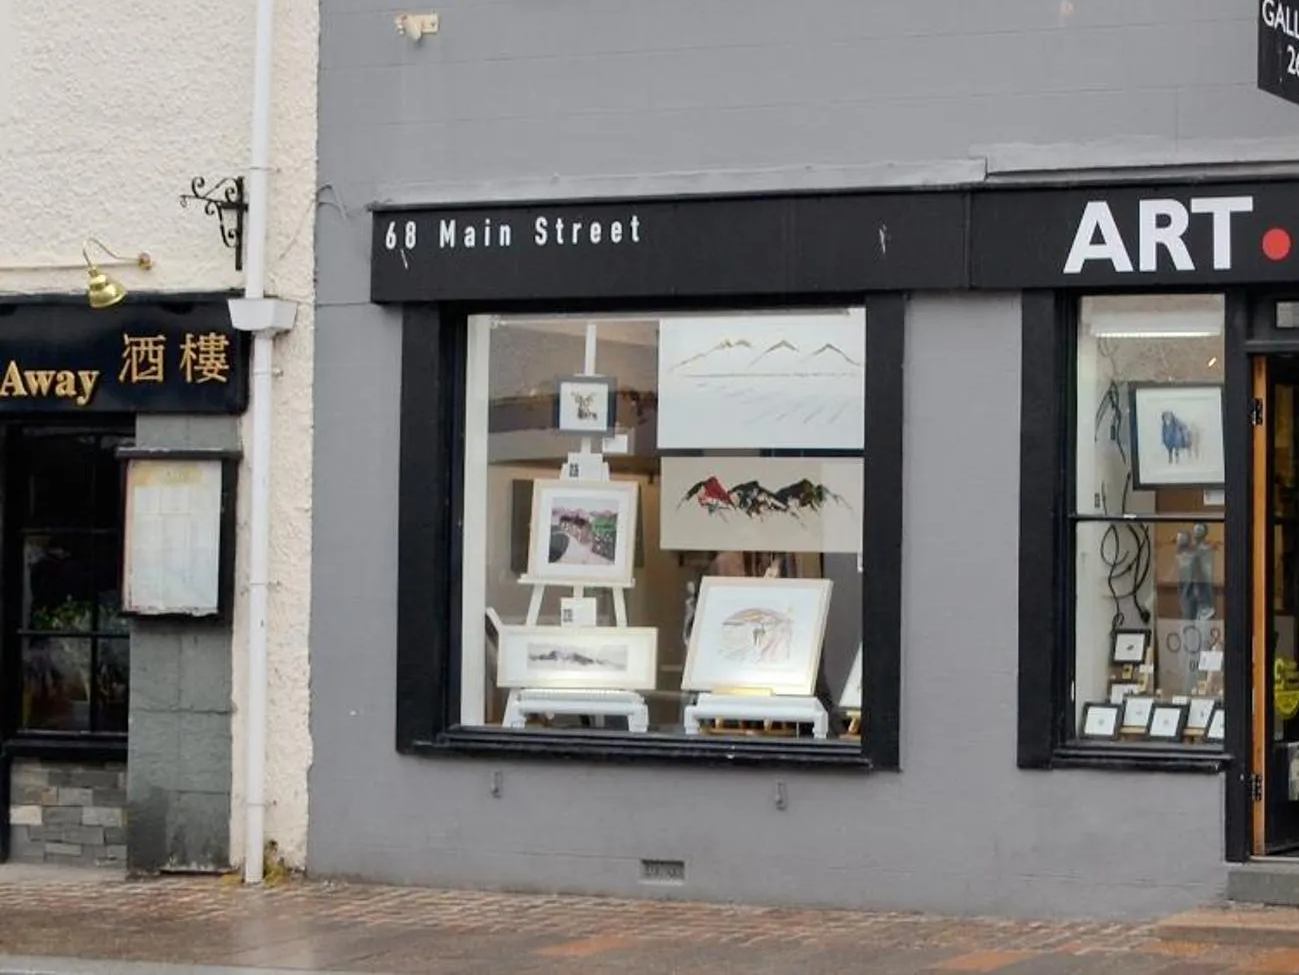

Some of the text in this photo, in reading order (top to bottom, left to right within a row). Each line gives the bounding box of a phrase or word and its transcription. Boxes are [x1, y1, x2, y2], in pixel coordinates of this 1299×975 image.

[385, 215, 640, 249] 68 Main Street
[1063, 196, 1253, 274] ART
[0, 360, 99, 405] Away
